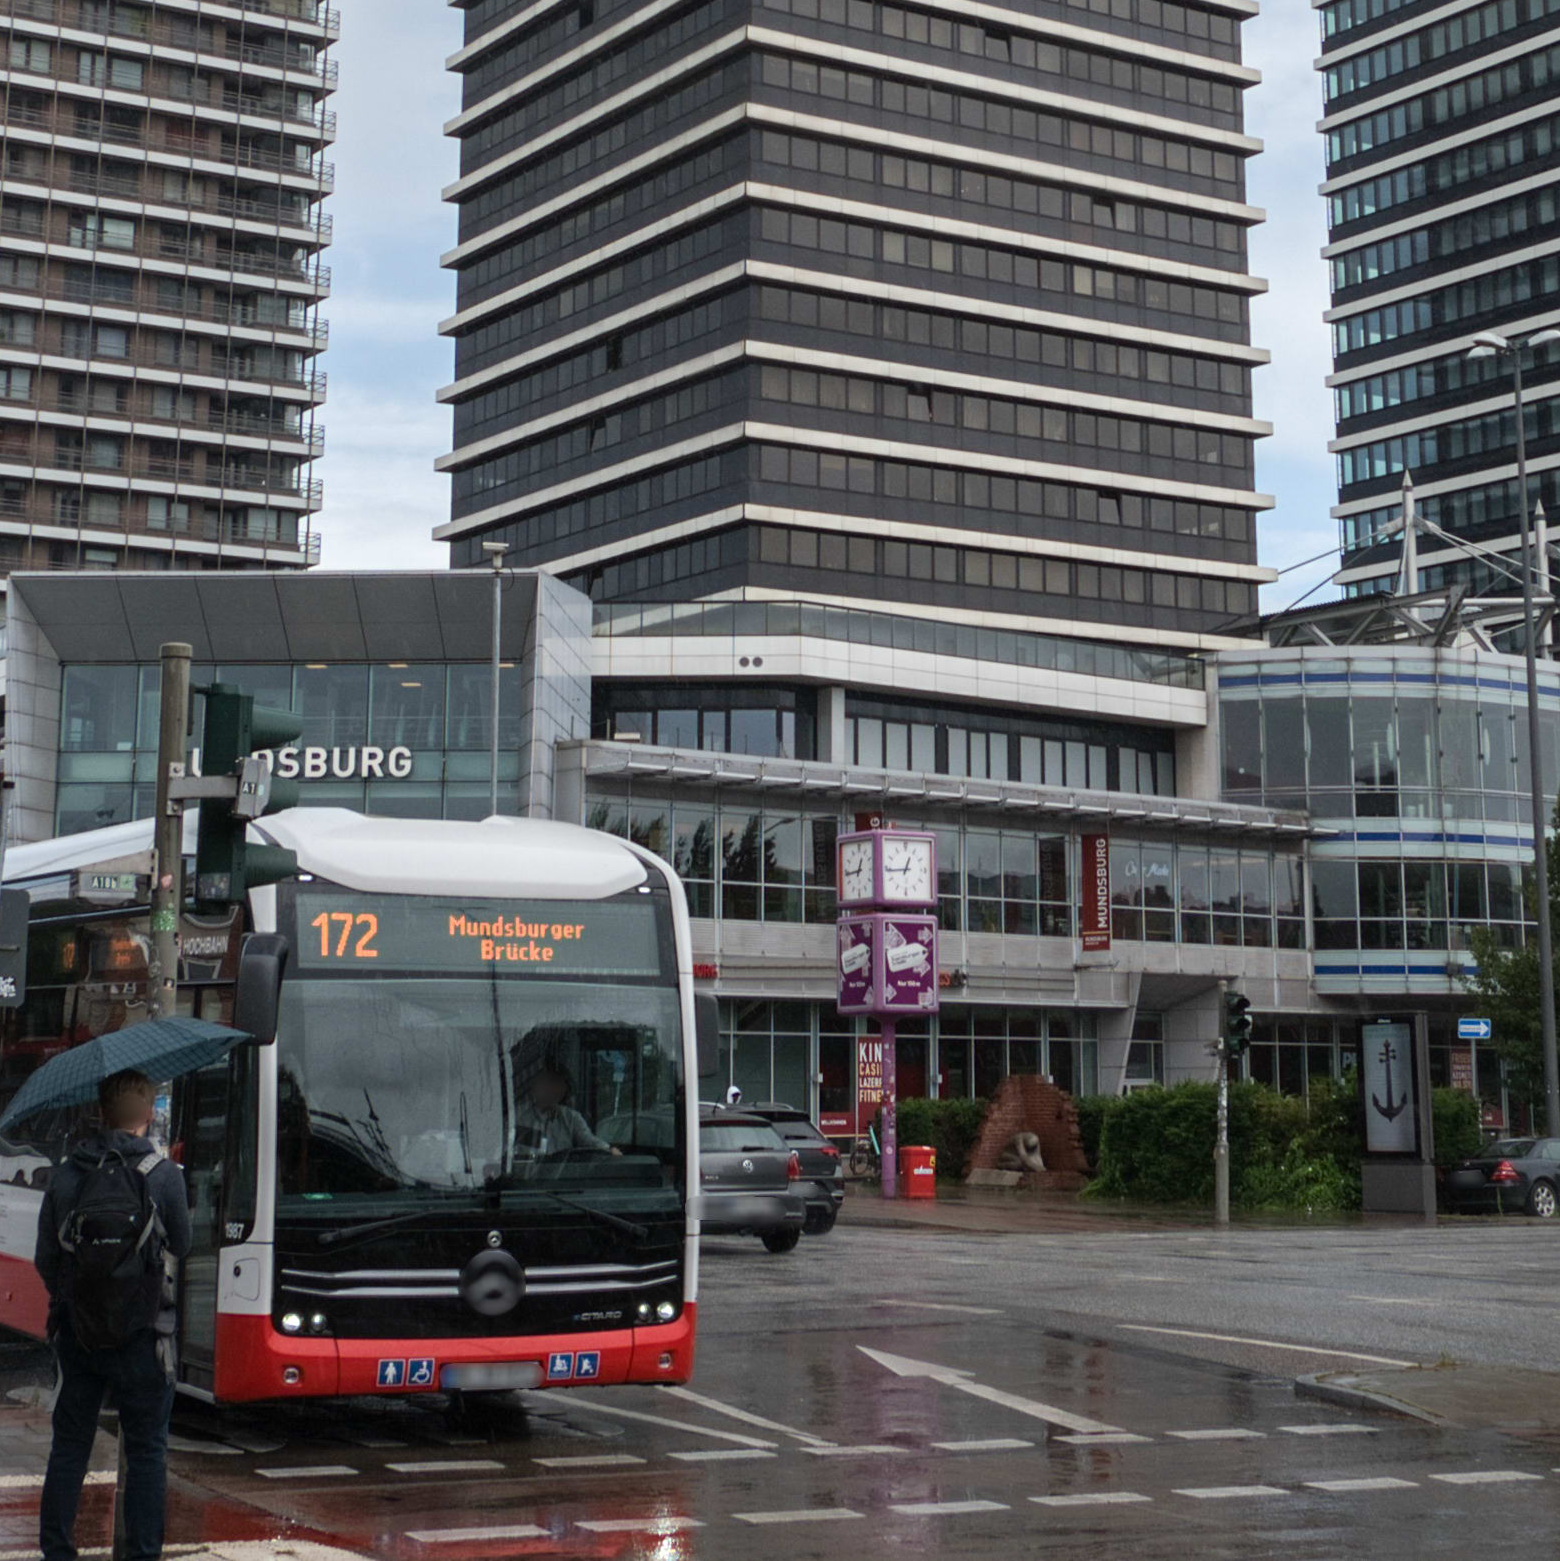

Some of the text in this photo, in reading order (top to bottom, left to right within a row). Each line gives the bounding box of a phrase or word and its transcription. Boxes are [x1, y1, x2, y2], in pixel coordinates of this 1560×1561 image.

[1096, 839, 1108, 928] MUNDSBURG
[311, 912, 378, 957] 172
[449, 915, 585, 940] Mundsburger
[183, 936, 229, 955] HOCHBAHN
[481, 939, 554, 962] Brücke
